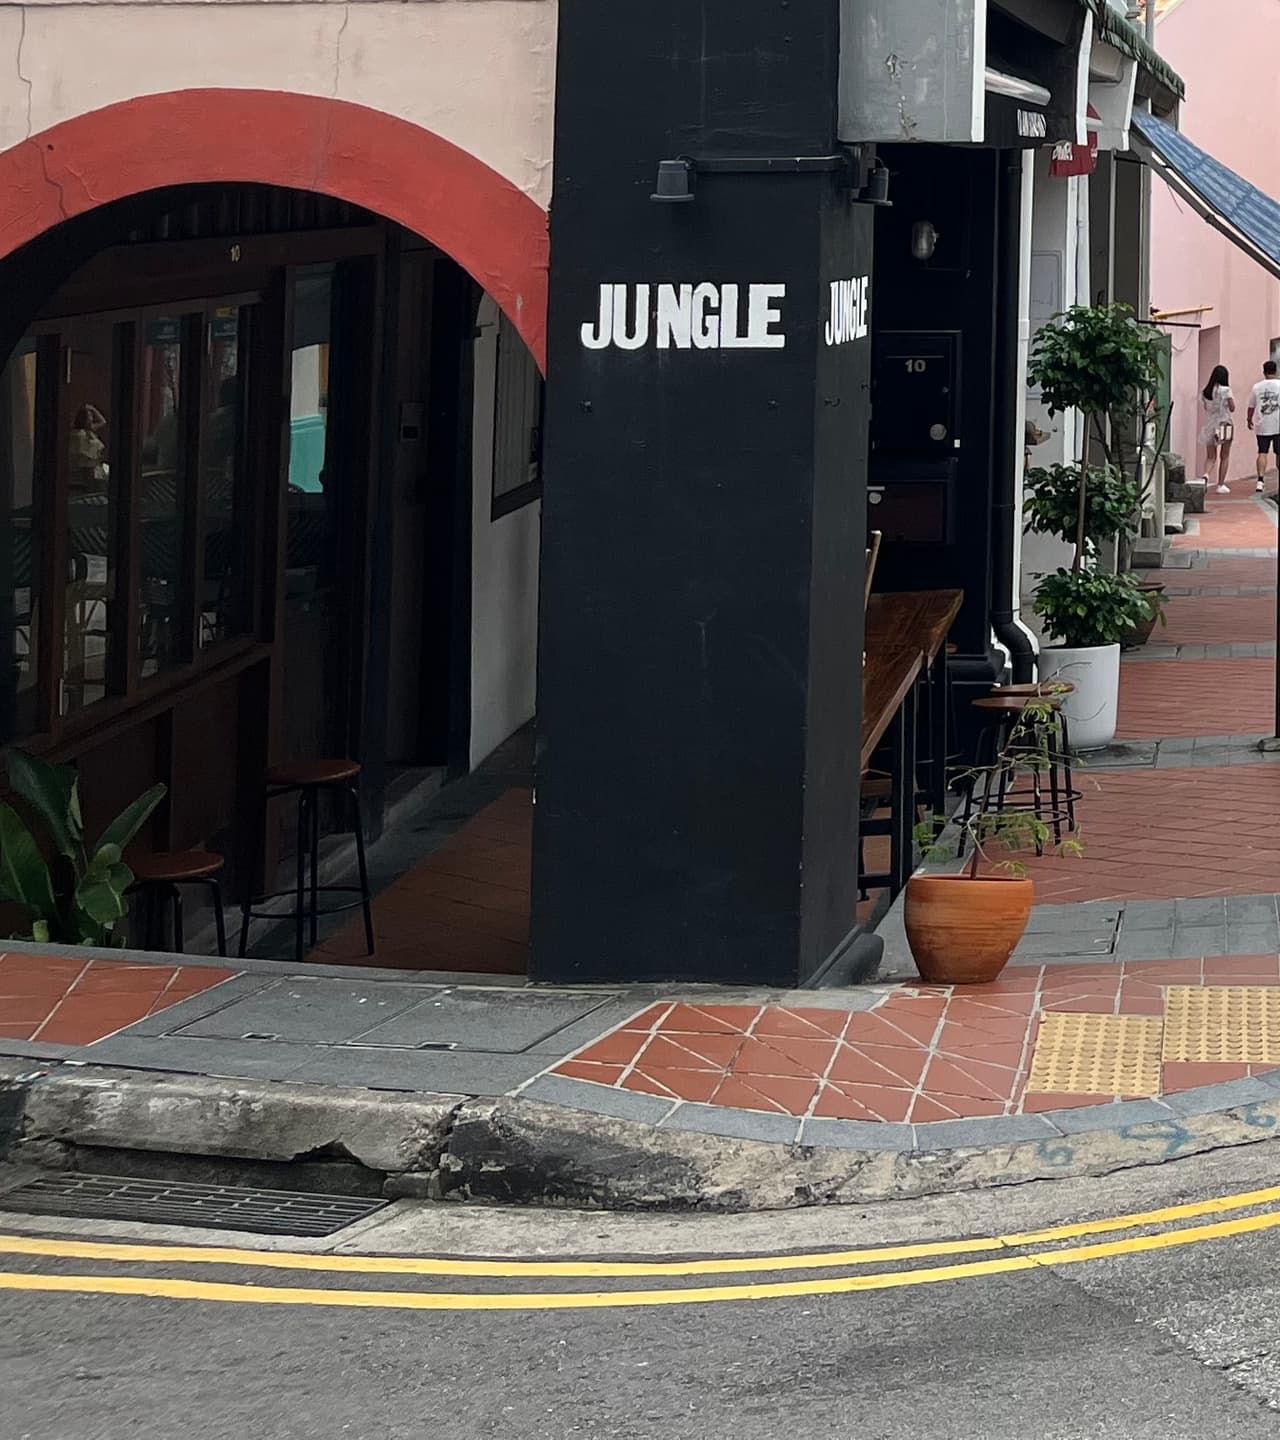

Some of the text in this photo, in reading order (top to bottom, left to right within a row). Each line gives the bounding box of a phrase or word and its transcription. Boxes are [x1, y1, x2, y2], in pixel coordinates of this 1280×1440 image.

[581, 282, 786, 350] JUNGLE
[824, 275, 870, 347] JUNGLE
[904, 359, 926, 373] 10
